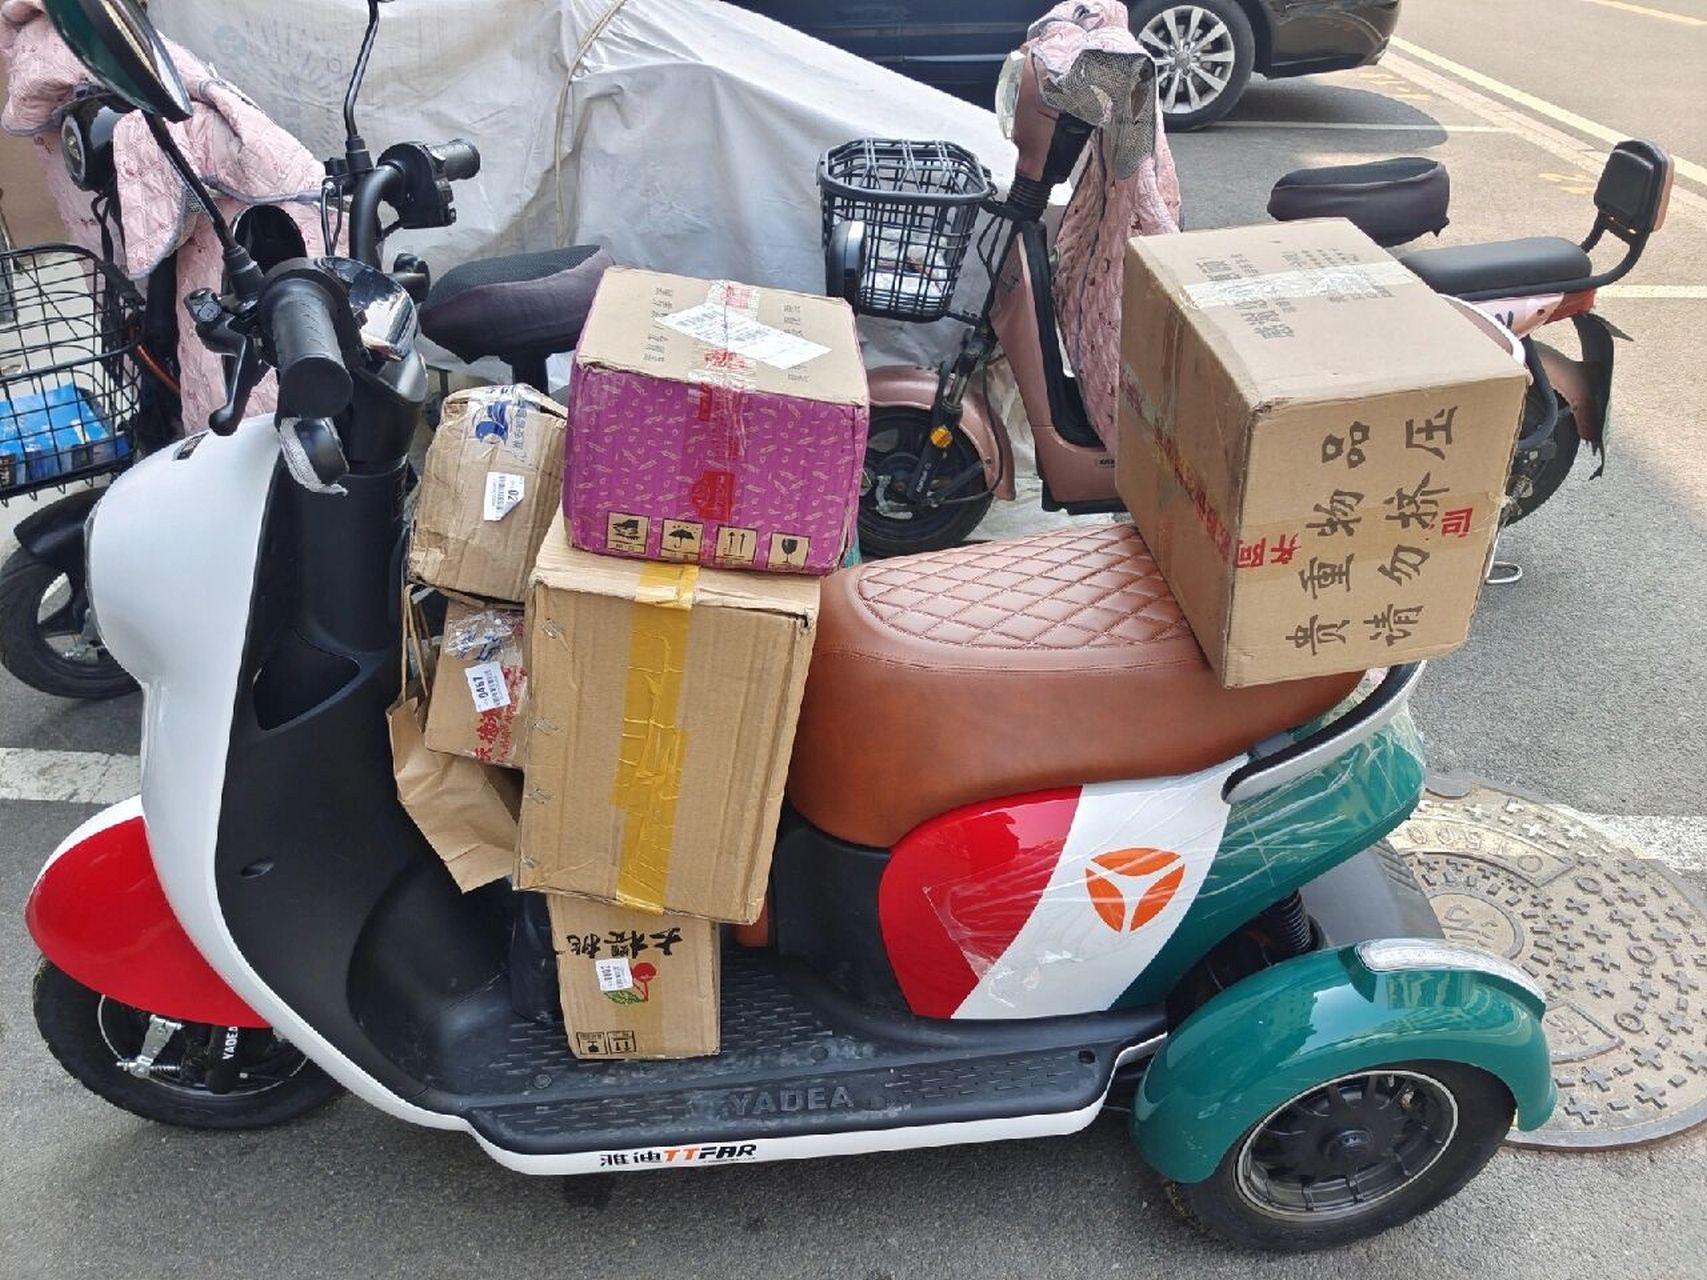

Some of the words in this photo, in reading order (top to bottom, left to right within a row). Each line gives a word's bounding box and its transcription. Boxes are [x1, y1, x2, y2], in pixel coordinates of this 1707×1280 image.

[1286, 422, 1370, 655] 贵重物品
[1364, 406, 1457, 647] 请勿挤压
[734, 1086, 853, 1115] YADEA
